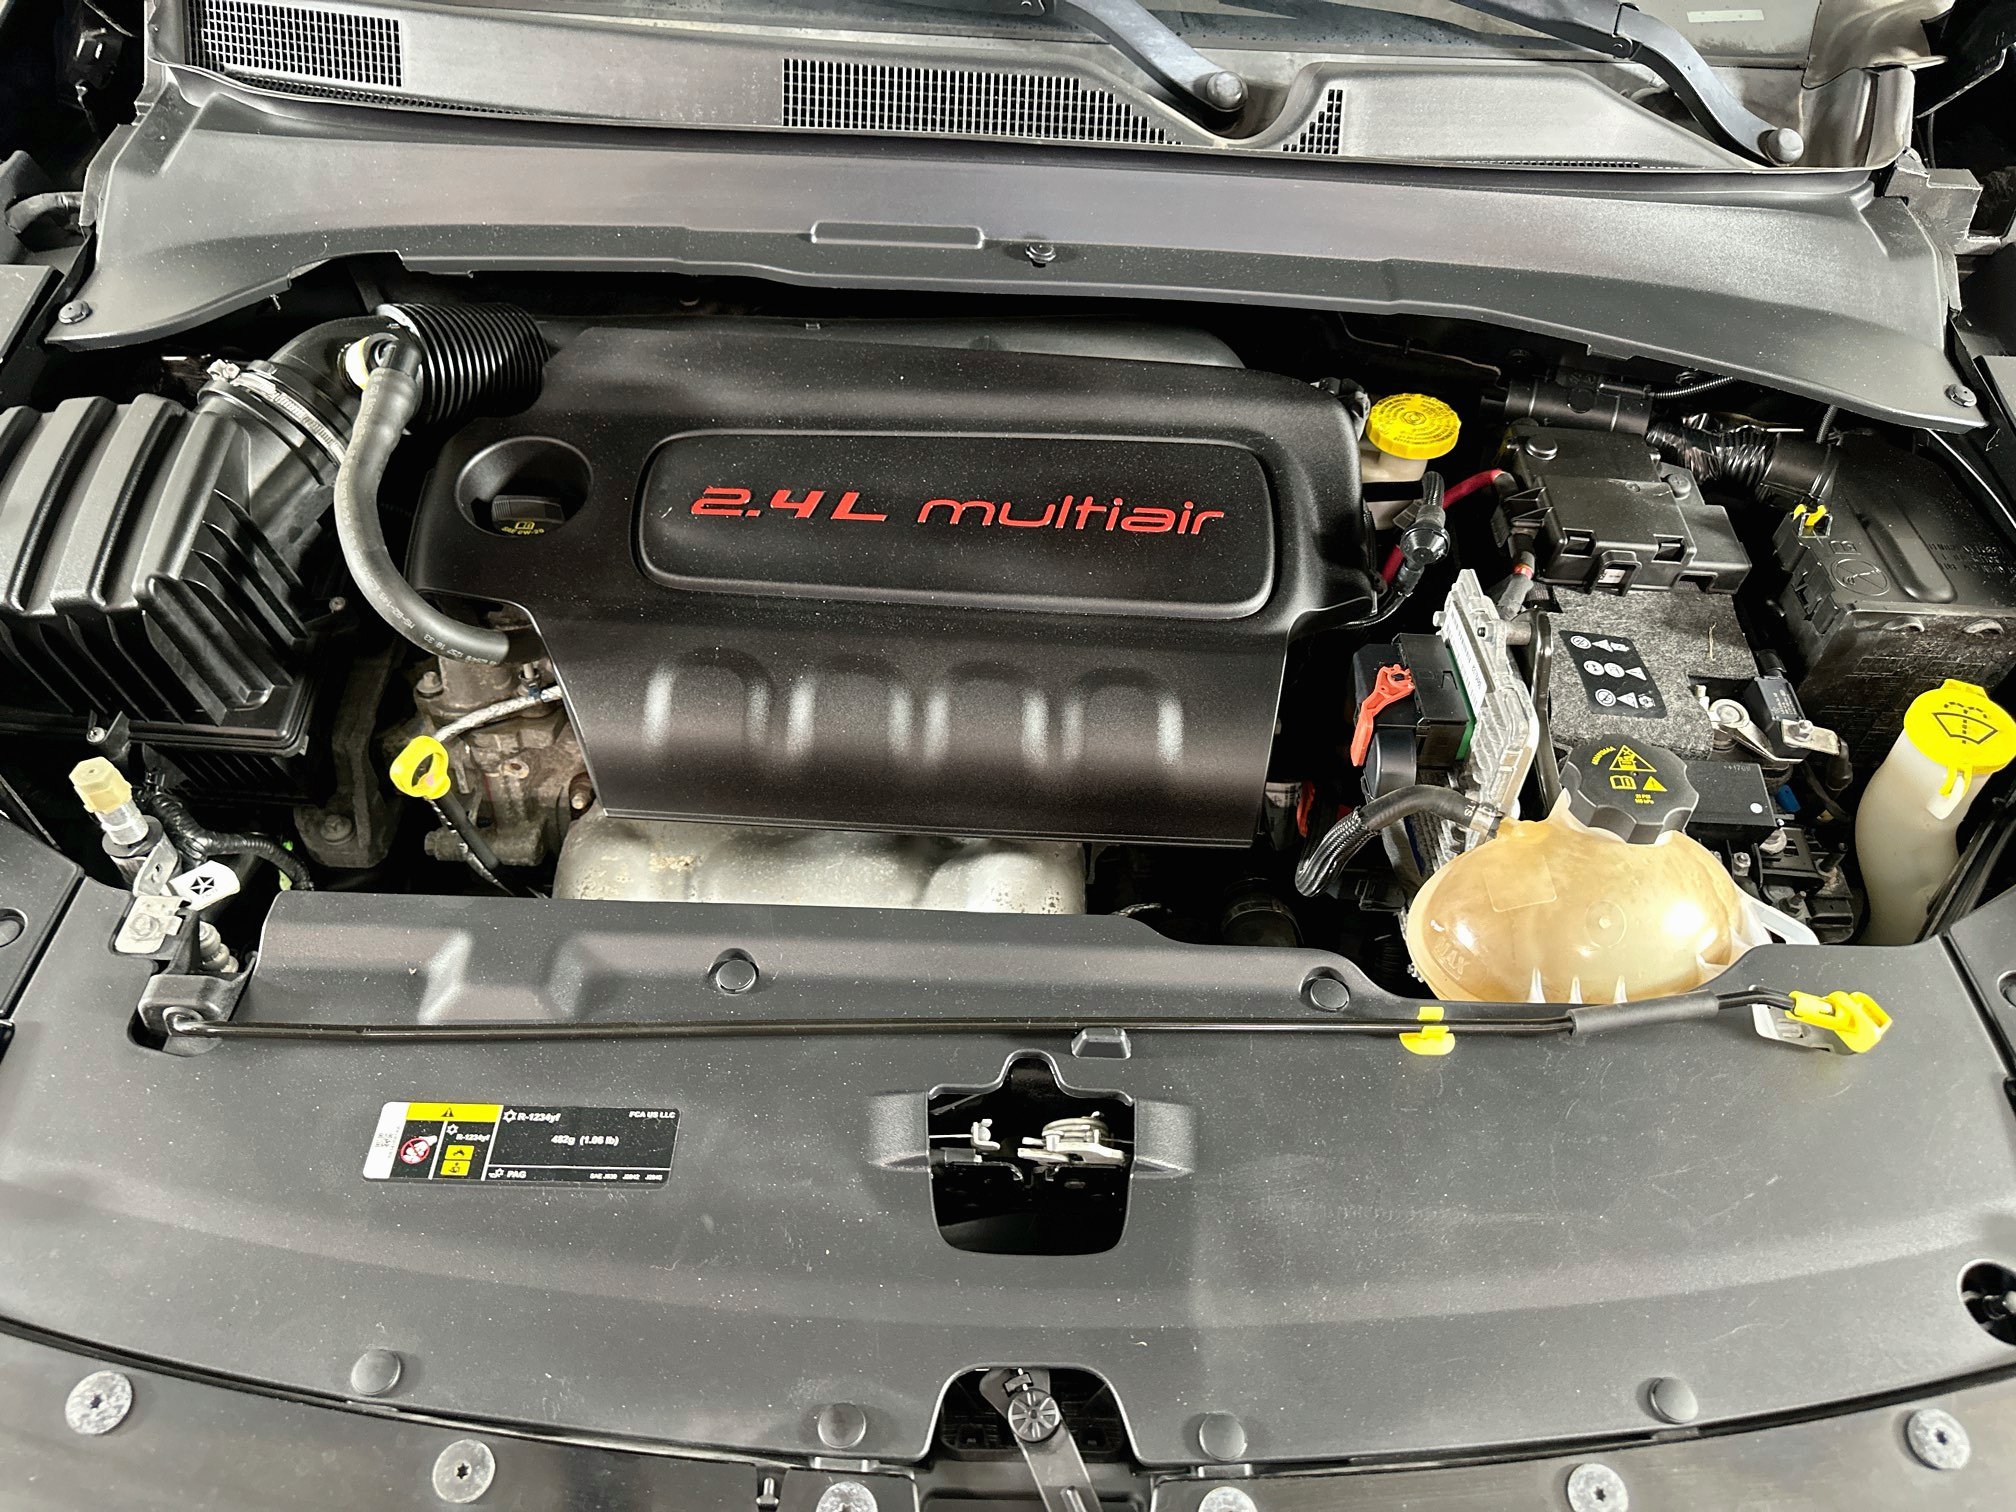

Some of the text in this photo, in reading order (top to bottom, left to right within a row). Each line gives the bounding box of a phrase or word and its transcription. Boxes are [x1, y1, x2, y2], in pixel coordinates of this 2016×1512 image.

[917, 494, 1223, 534] multiair
[517, 1112, 562, 1123] R-1234yf
[660, 1111, 676, 1119] LLC
[506, 1170, 527, 1179] PAG
